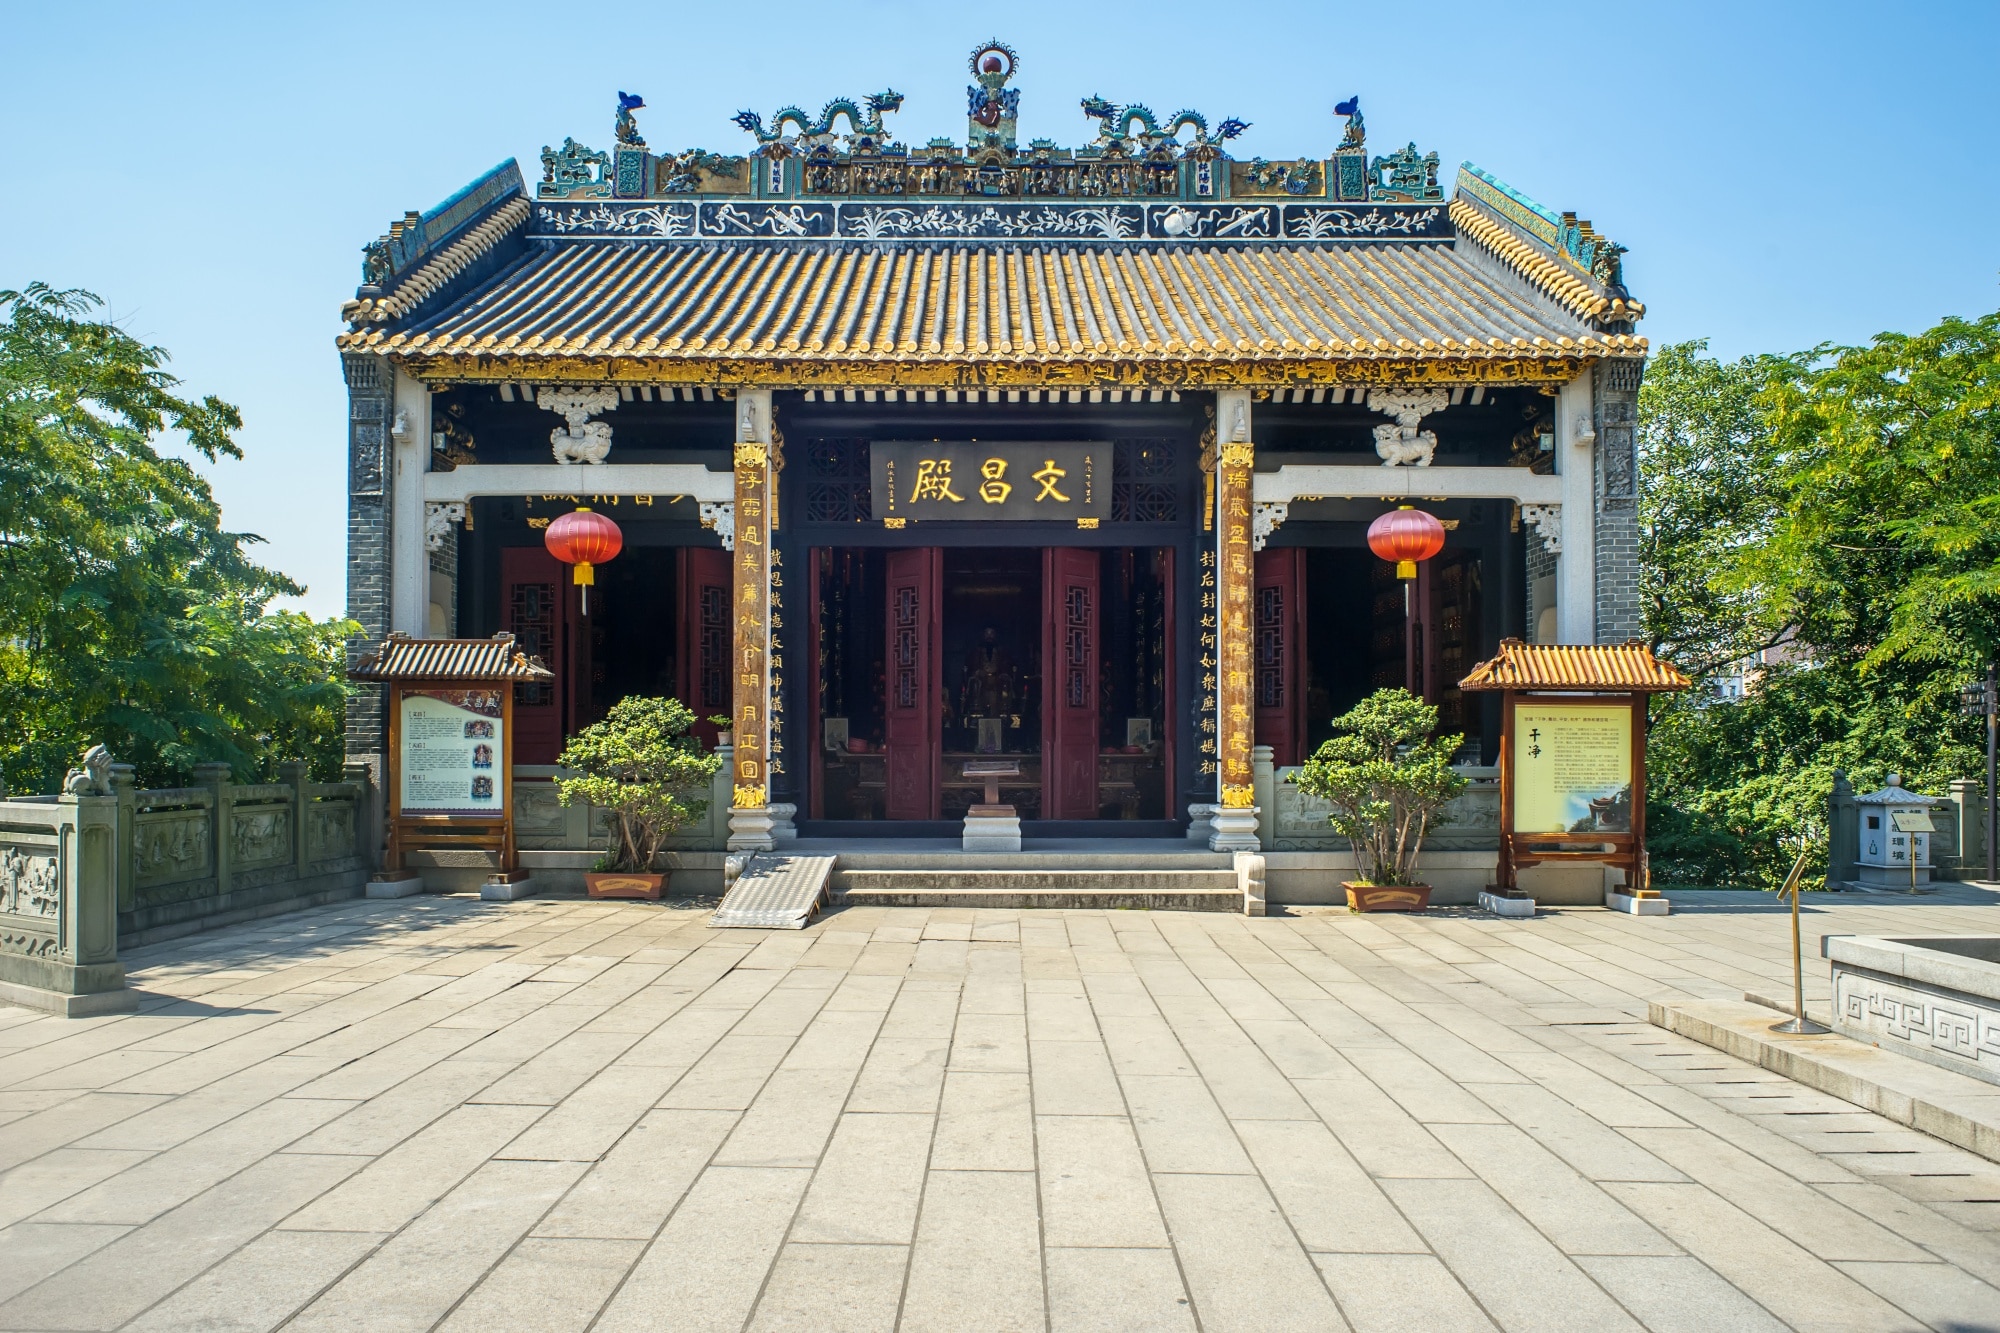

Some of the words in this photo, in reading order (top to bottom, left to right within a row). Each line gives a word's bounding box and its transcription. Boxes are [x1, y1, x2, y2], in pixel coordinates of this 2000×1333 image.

[909, 457, 1072, 504] 文昌殿
[460, 697, 498, 708] 文昌殿
[1528, 728, 1542, 759] 干净
